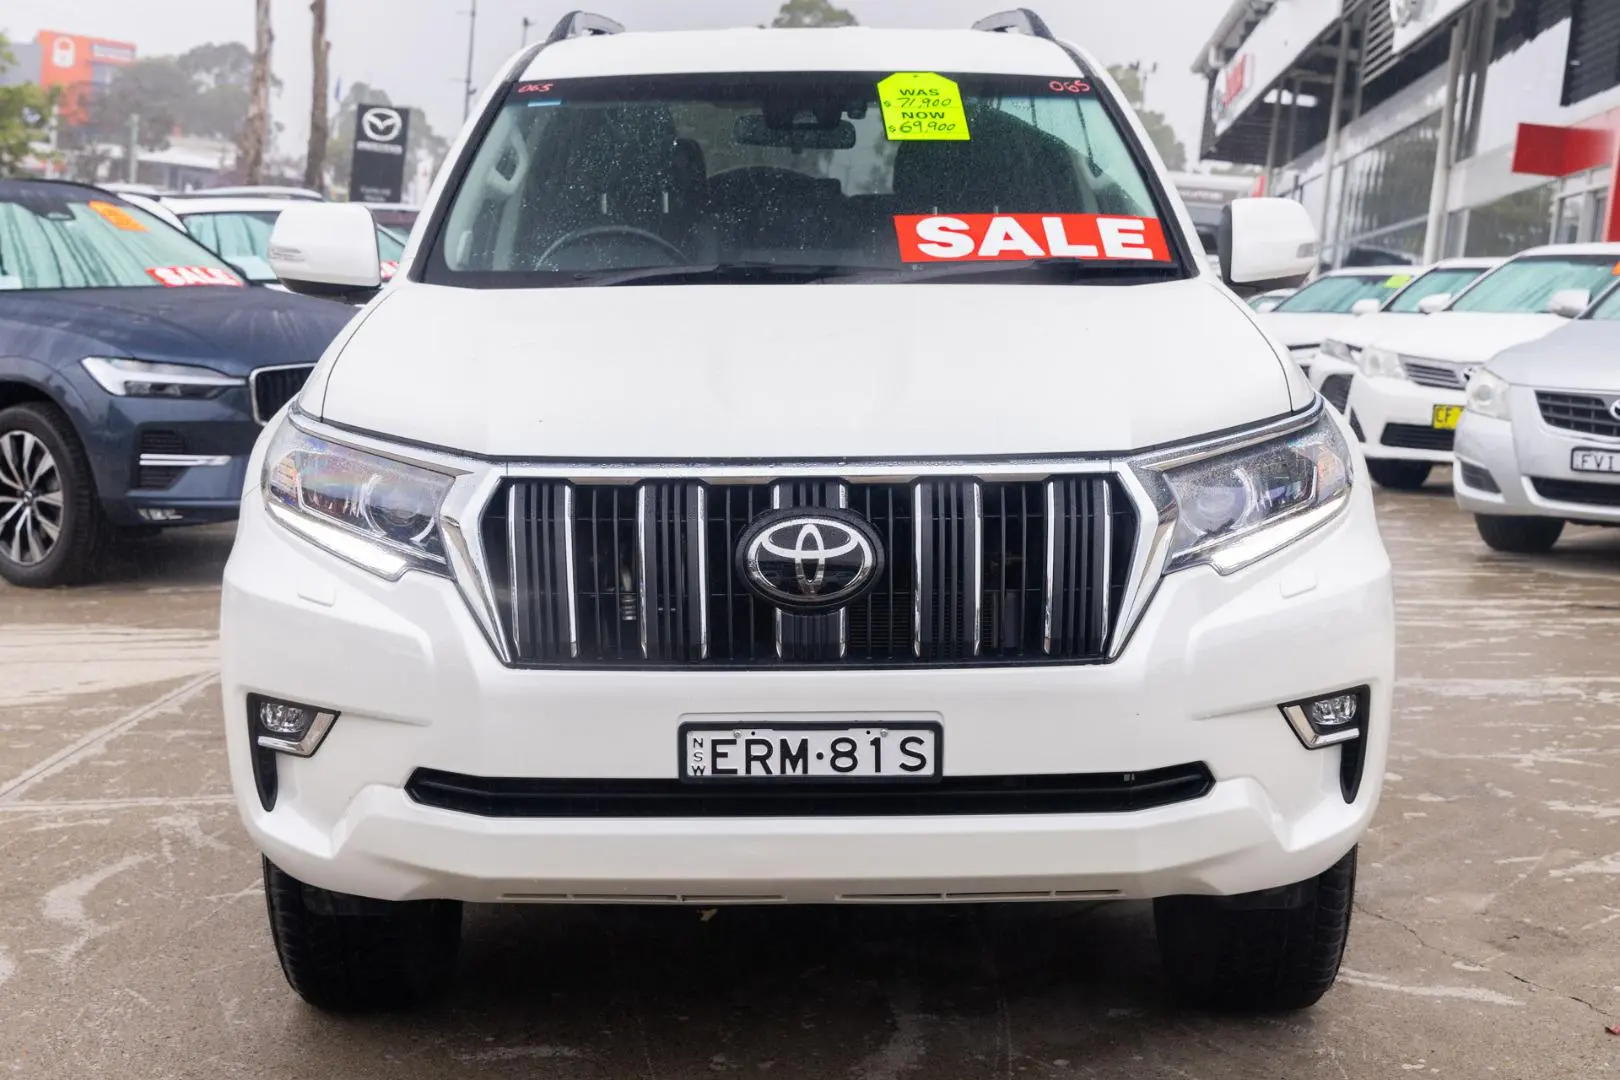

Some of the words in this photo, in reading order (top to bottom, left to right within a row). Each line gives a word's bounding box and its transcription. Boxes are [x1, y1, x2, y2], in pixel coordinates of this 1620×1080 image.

[1049, 80, 1090, 92] 065
[915, 216, 1153, 259] SALE
[153, 267, 241, 286] SALE
